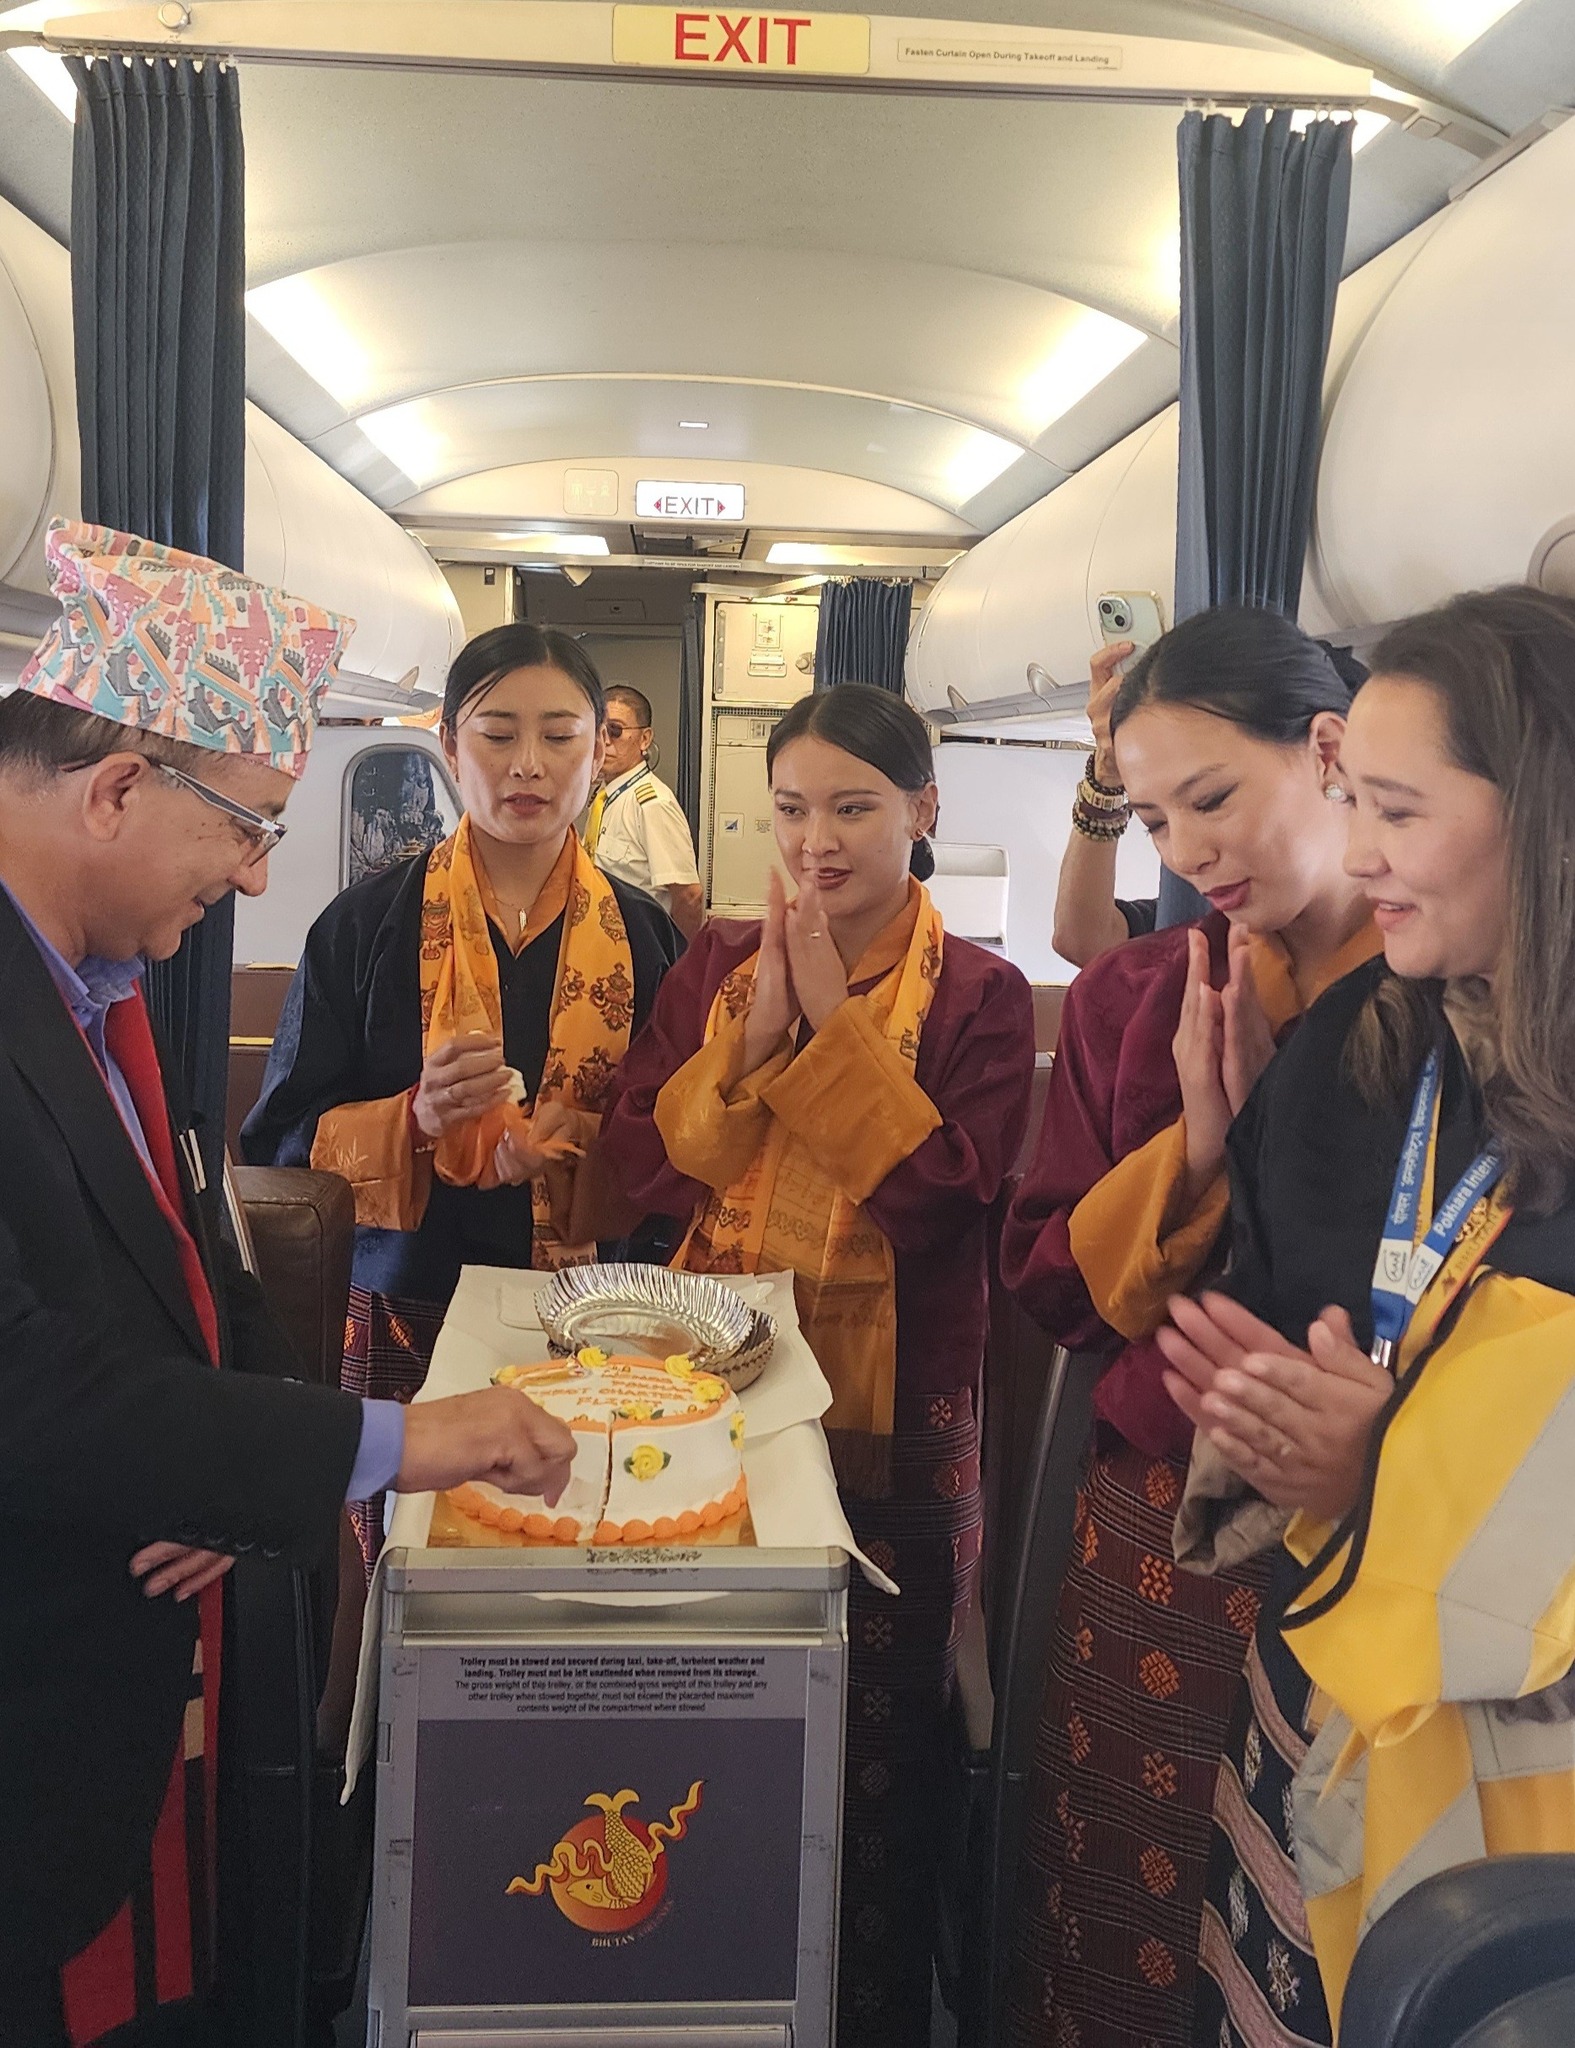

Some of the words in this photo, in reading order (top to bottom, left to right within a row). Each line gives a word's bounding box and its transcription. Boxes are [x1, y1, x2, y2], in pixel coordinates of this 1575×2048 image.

[675, 13, 811, 65] EXIT
[905, 47, 934, 56] Fasten
[936, 48, 967, 57] Curtain
[969, 50, 991, 60] Open
[994, 51, 1021, 61] During
[1024, 52, 1055, 60] Takeoff
[1075, 54, 1109, 64] Landing
[665, 496, 714, 515] EXIT
[1433, 1184, 1472, 1238] Pokhara
[460, 1657, 486, 1667] Trolley
[488, 1657, 508, 1666] must
[510, 1657, 519, 1666] be
[521, 1657, 549, 1666] stowed
[551, 1657, 565, 1666] and
[567, 1657, 598, 1666] secured
[600, 1657, 625, 1667] during
[627, 1657, 645, 1666] taxi,
[647, 1657, 680, 1666] take-off,
[681, 1656, 716, 1665] turbulent
[718, 1656, 749, 1665] weather
[750, 1656, 765, 1665] and
[464, 1669, 496, 1679] landing.
[499, 1669, 525, 1679] Trolley
[527, 1669, 547, 1677] must
[549, 1669, 562, 1677] not
[563, 1669, 573, 1677] be
[575, 1669, 588, 1677] left
[589, 1669, 633, 1677] unattended
[635, 1669, 656, 1677] when
[657, 1669, 692, 1677] removed
[693, 1669, 711, 1677] from
[713, 1669, 723, 1677] its
[724, 1669, 758, 1679] stowage.
[456, 1681, 469, 1689] The
[471, 1682, 493, 1691] gross
[495, 1680, 521, 1690] weight
[522, 1680, 530, 1688] of
[532, 1680, 546, 1689] this
[548, 1681, 574, 1691] trolley,
[586, 1680, 598, 1688] the
[600, 1680, 637, 1689] combined
[638, 1681, 660, 1690] gross
[661, 1680, 687, 1689] weight
[688, 1680, 696, 1688] of
[697, 1680, 712, 1688] this
[714, 1680, 737, 1690] trolley
[738, 1680, 753, 1688] and
[754, 1681, 768, 1690] any
[468, 1693, 488, 1701] other
[490, 1693, 514, 1702] trolley
[515, 1692, 537, 1700] when
[539, 1692, 565, 1700] stowed
[567, 1692, 600, 1702] together,
[602, 1692, 621, 1700] must
[665, 1692, 678, 1700] the
[679, 1692, 716, 1702] placarded
[716, 1692, 755, 1700] maximum
[517, 1704, 550, 1712] contents
[551, 1704, 577, 1713] weight
[578, 1703, 587, 1711] of
[588, 1703, 600, 1712] the
[601, 1703, 652, 1713] compartment
[653, 1703, 677, 1711] where
[678, 1703, 706, 1711] stowed
[591, 1935, 635, 1948] BHUTAN
